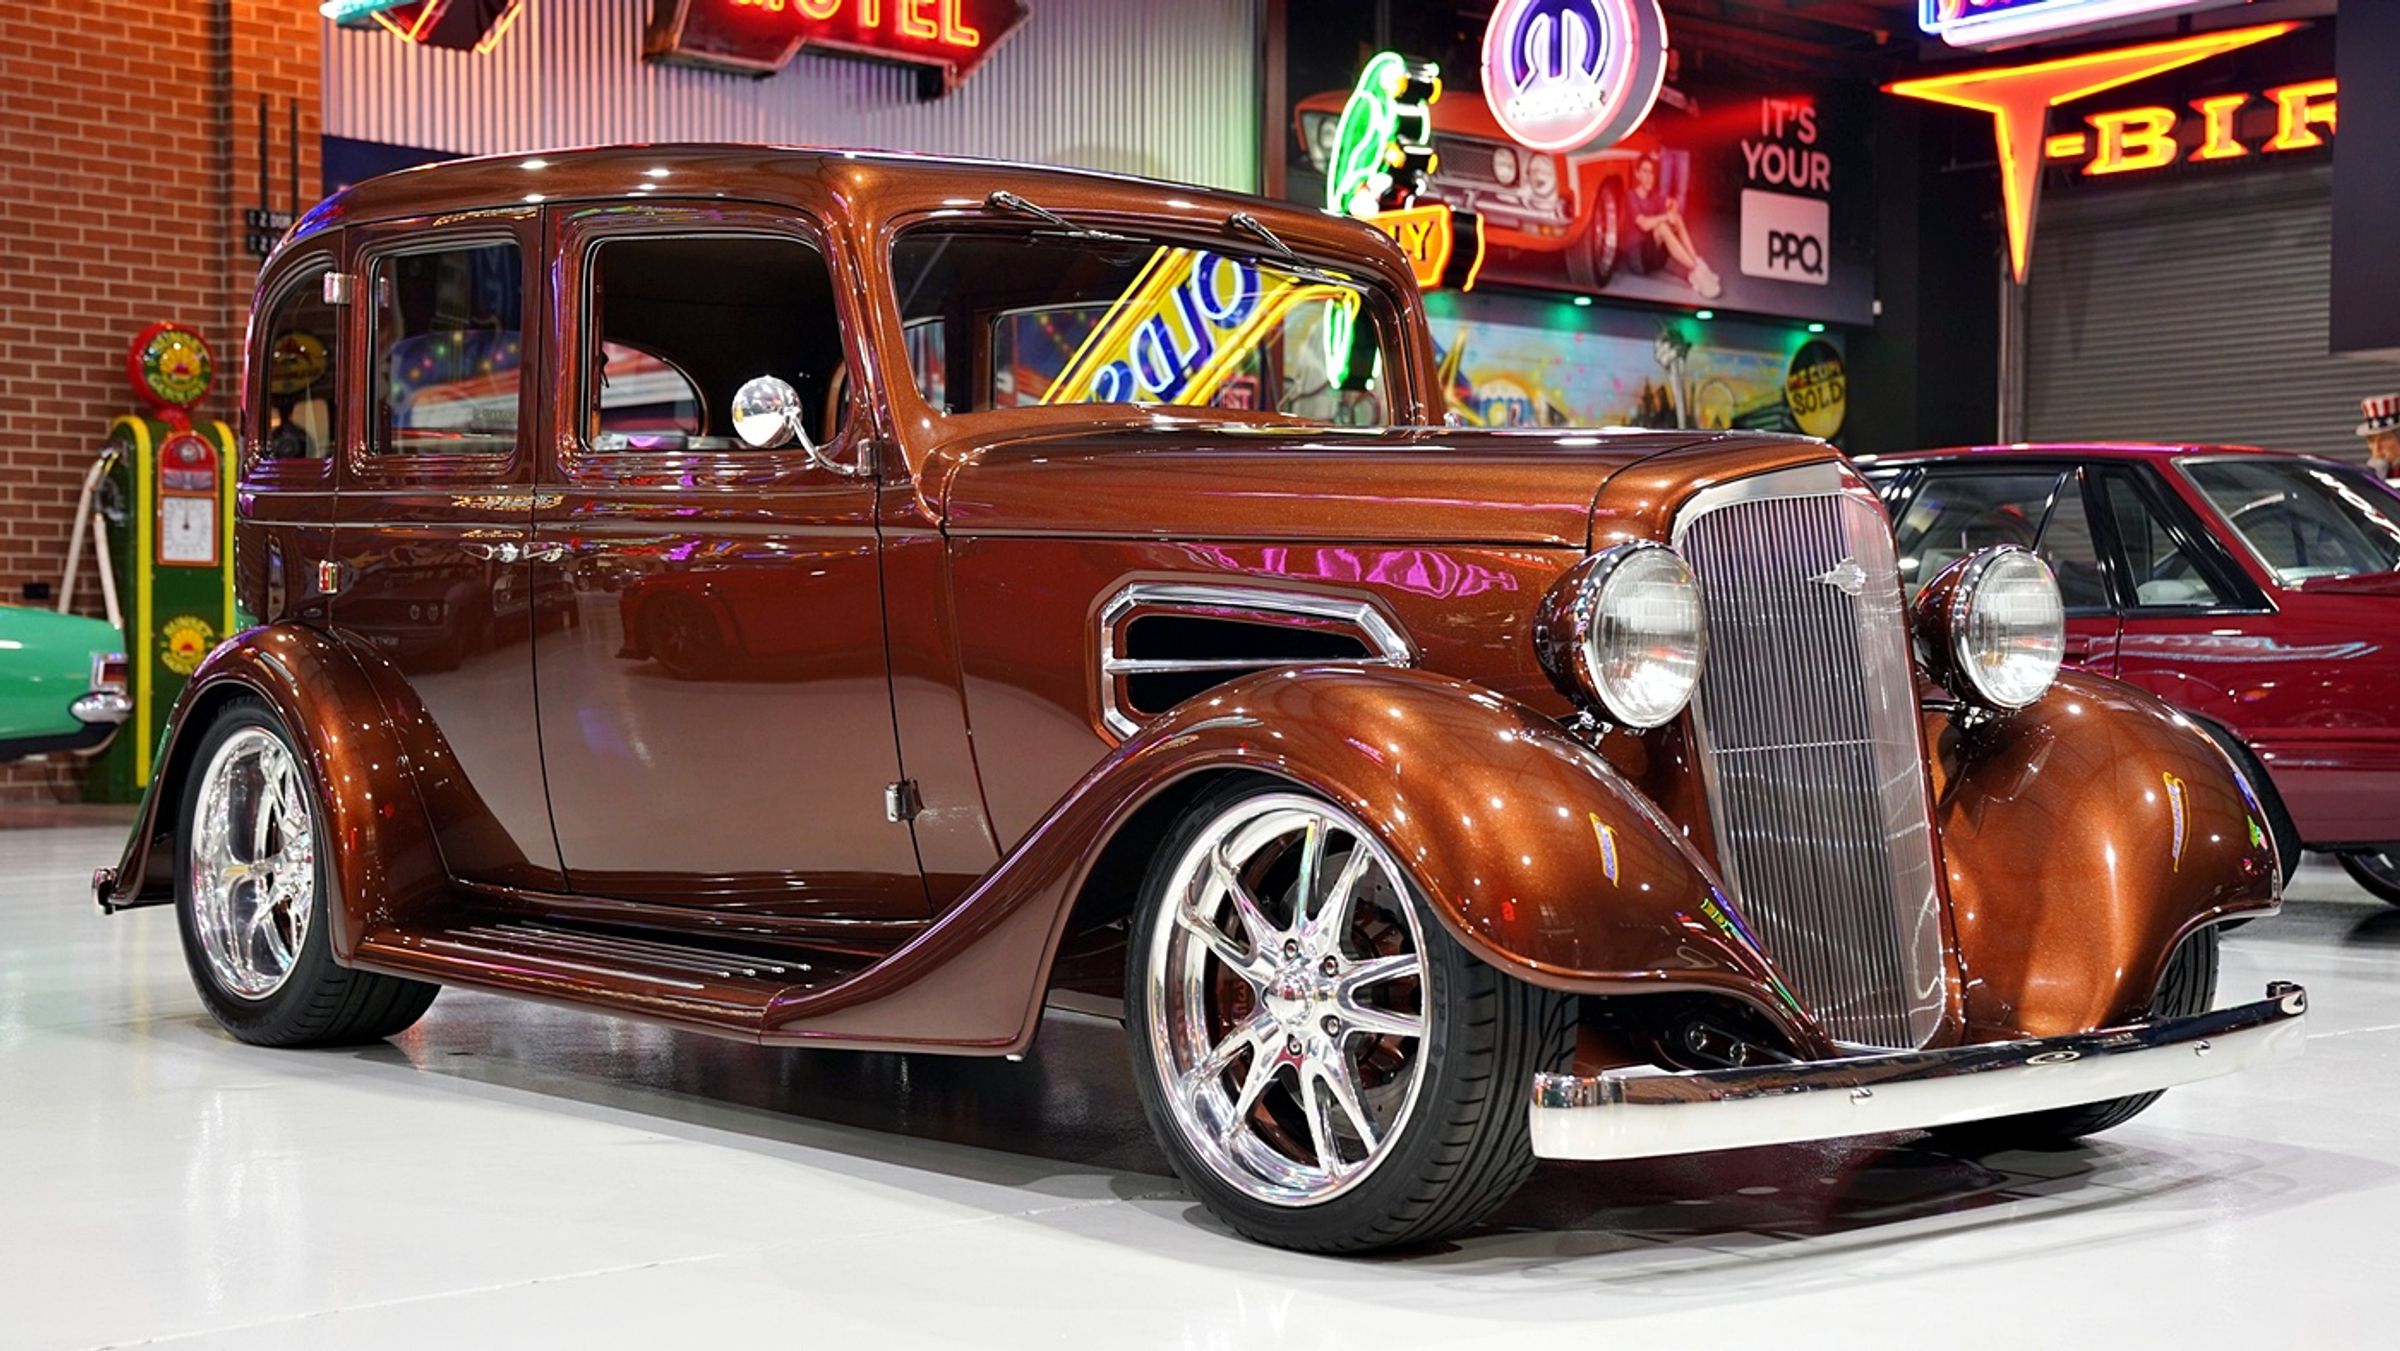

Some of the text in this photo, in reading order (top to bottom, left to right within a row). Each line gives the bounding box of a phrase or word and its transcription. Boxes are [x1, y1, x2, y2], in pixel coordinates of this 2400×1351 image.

[1762, 97, 1816, 144] IT'S
[1741, 138, 1831, 192] YOUR
[1769, 230, 1824, 276] PPQ
[1792, 381, 1844, 416] SOLD
